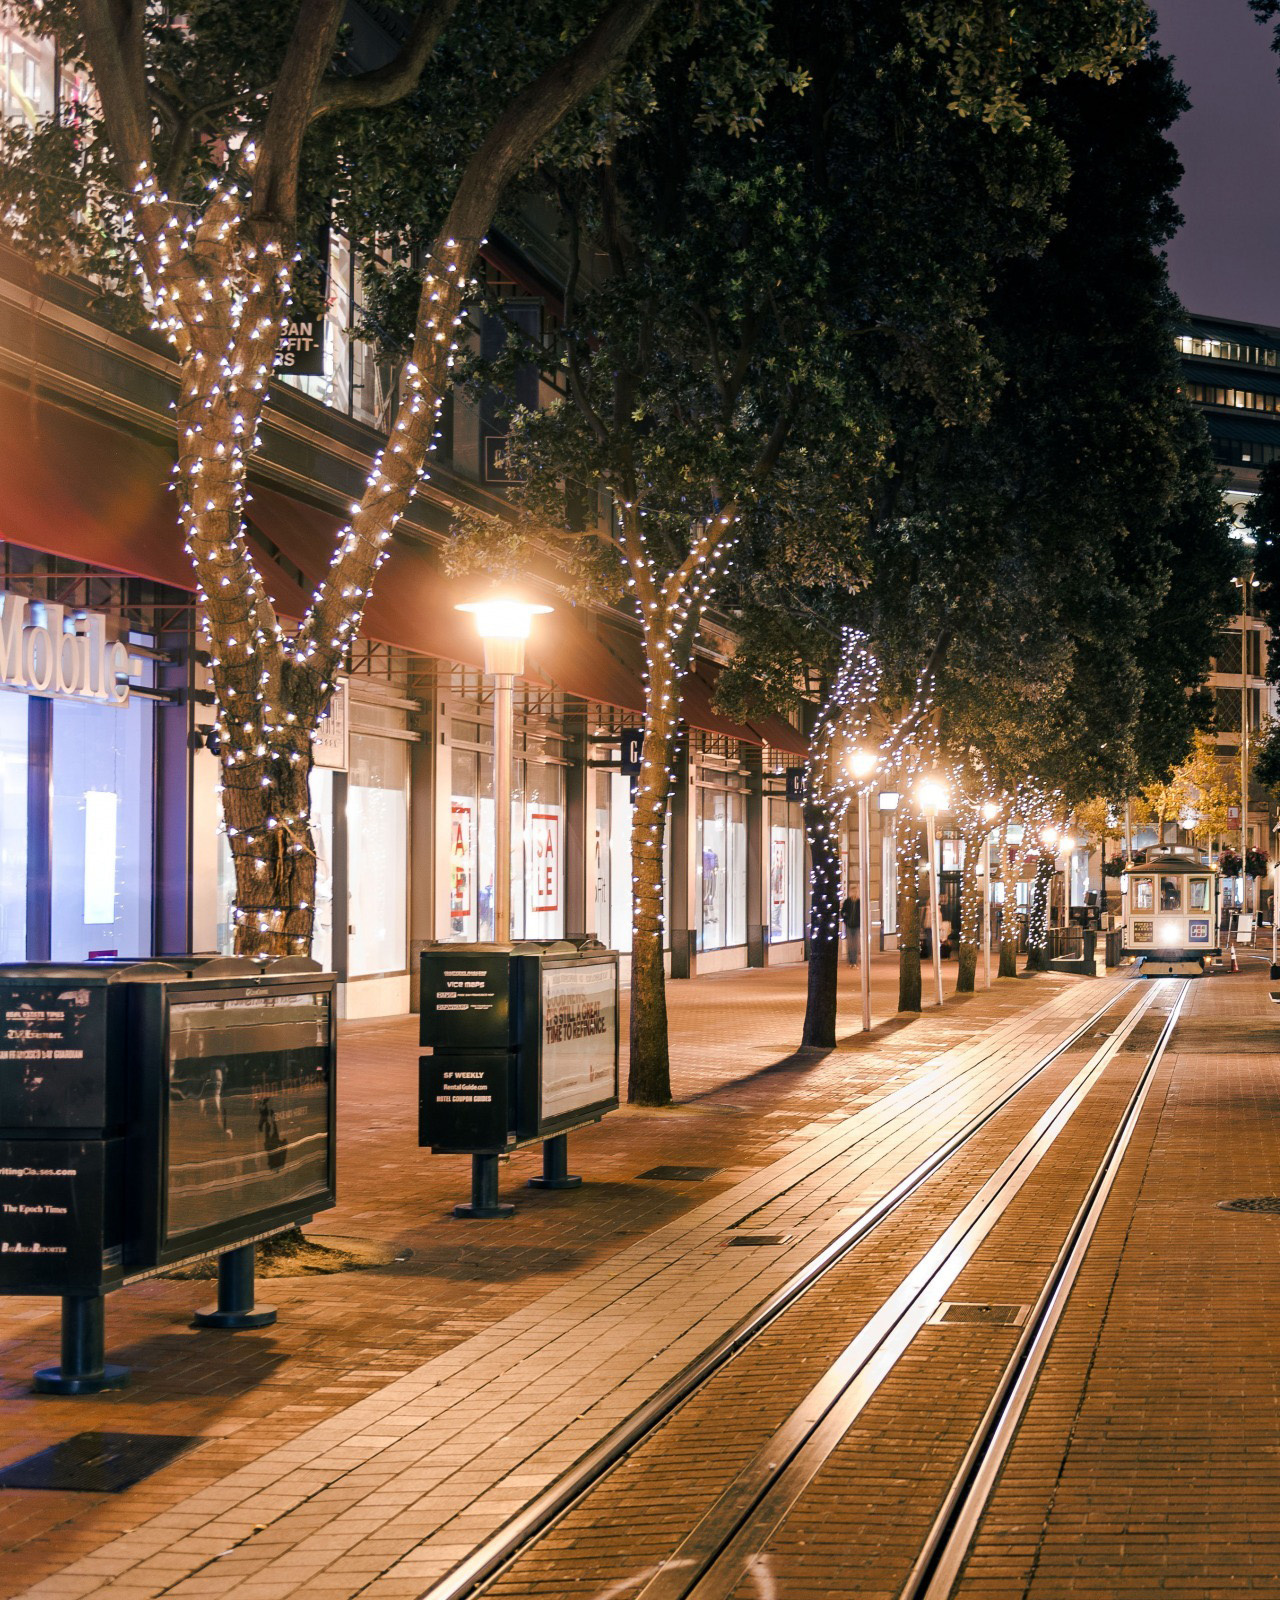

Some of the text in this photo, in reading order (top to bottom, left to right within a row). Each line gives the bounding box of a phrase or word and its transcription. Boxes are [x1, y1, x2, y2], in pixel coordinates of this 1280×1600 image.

[559, 1005, 576, 1025] STILL
[581, 1000, 601, 1020] GREAT
[546, 1024, 562, 1045] TIME
[563, 1022, 572, 1041] TO
[3, 1204, 67, 1214] The Epoch Times
